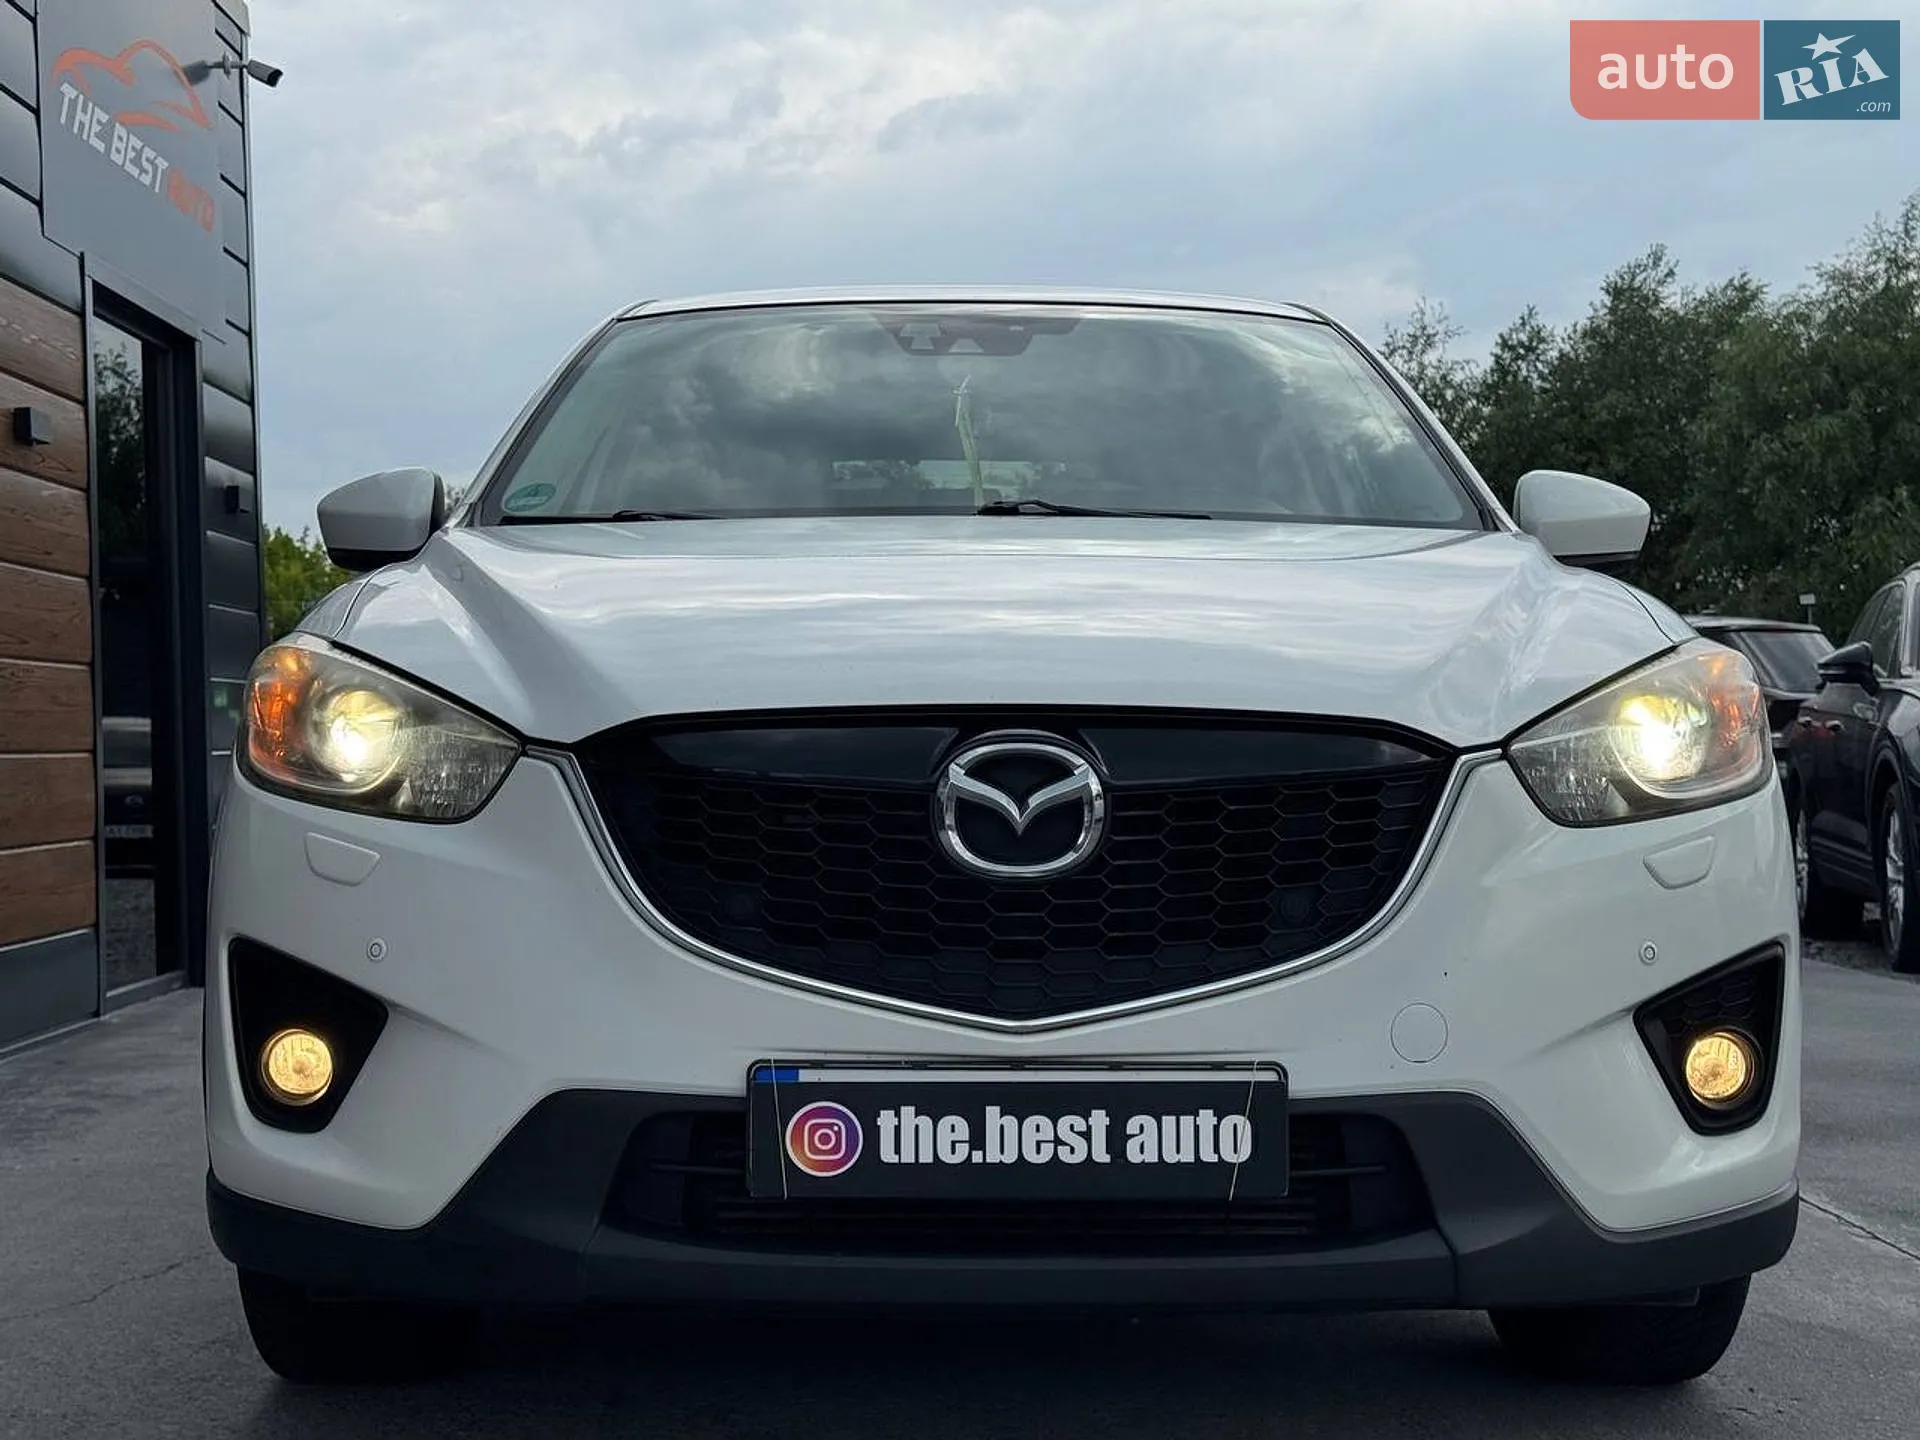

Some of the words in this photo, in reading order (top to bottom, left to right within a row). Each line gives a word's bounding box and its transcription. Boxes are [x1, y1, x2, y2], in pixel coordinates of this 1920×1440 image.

[60, 82, 109, 154] THE
[110, 122, 169, 193] BEST
[876, 1105, 1110, 1164] the.best
[1125, 1108, 1253, 1164] auto
